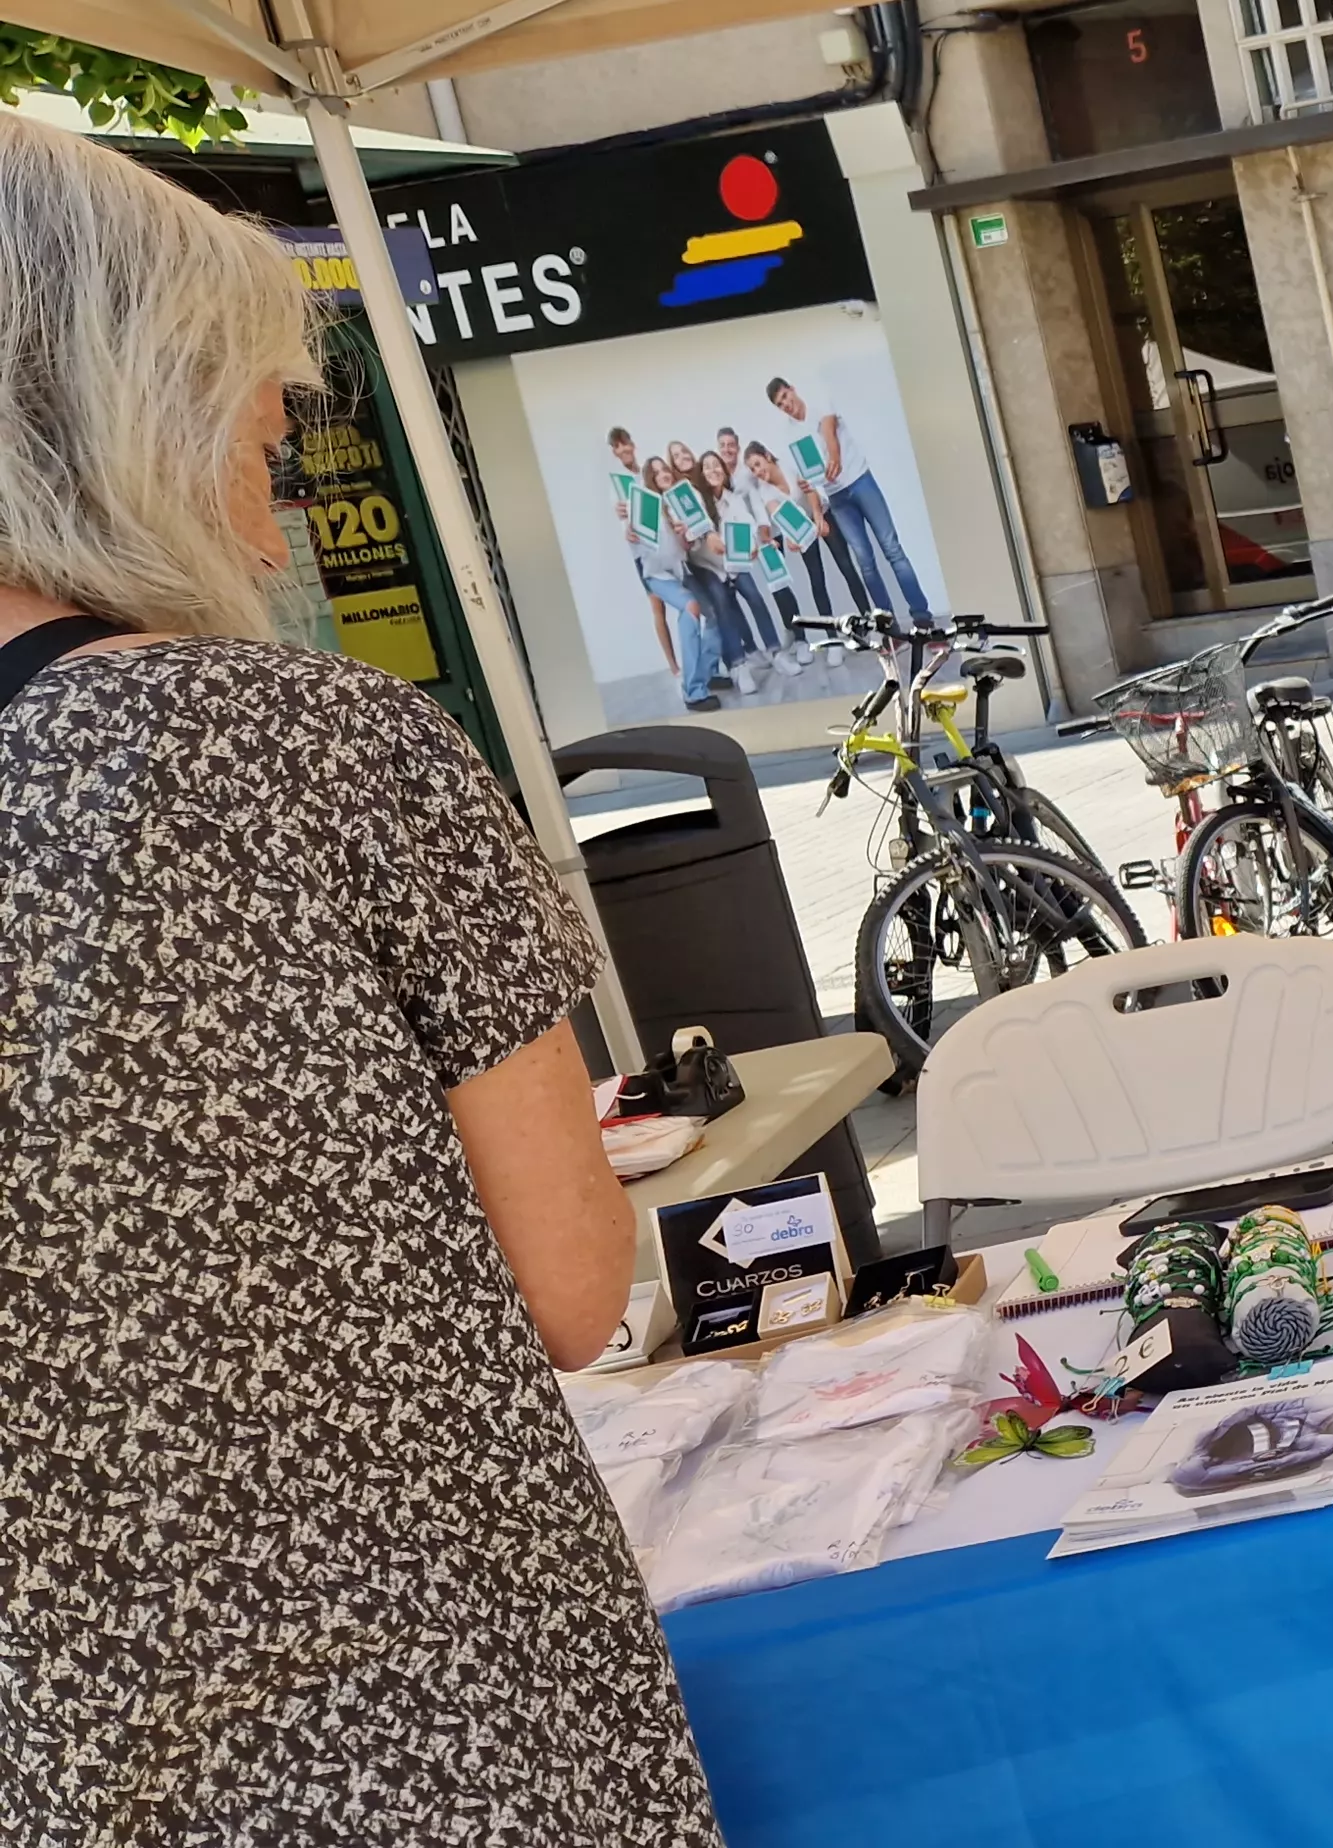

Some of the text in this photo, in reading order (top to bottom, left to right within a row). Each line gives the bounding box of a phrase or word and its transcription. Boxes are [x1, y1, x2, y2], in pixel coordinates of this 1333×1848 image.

[1127, 29, 1148, 64] 5
[308, 495, 400, 550] 120
[322, 543, 406, 569] MILLONES
[341, 603, 421, 625] MILLONARIO
[770, 1223, 814, 1242] debra
[696, 1264, 803, 1298] CUARZOS
[1115, 1336, 1155, 1374] 2 €
